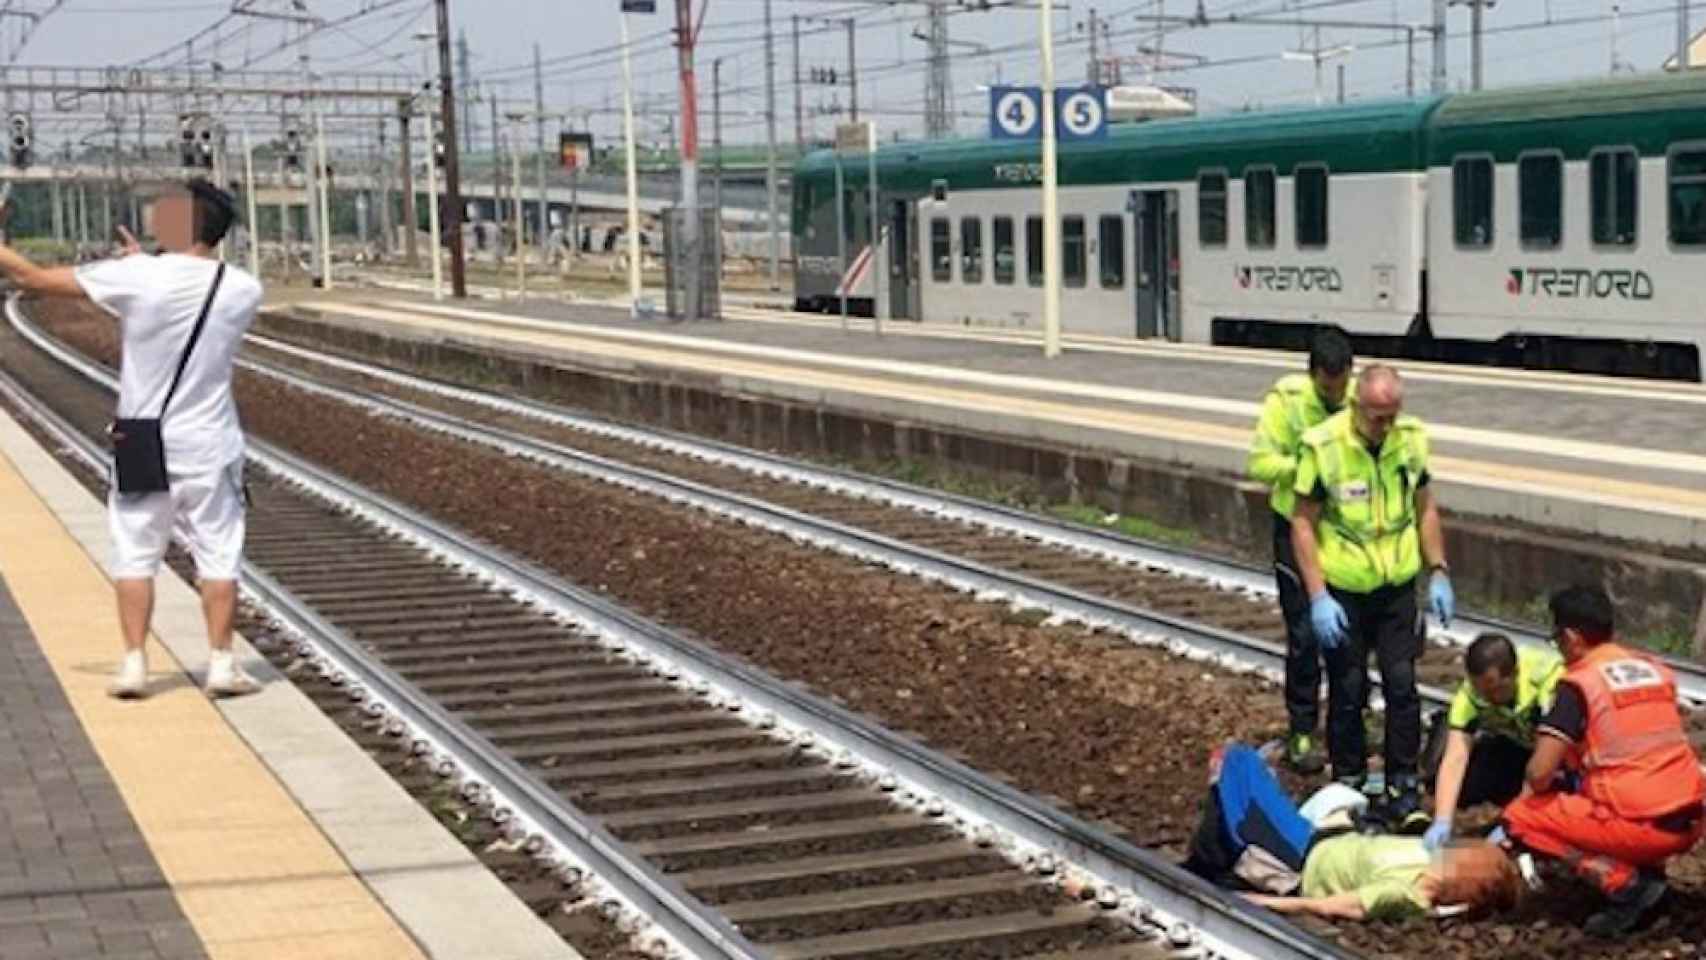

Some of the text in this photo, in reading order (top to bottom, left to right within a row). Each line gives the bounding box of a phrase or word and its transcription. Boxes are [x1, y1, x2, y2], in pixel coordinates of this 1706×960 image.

[1005, 100, 1025, 128] 4
[1073, 101, 1091, 128] 5
[1254, 266, 1341, 291] TRENORD
[1526, 268, 1653, 299] TRENORD
